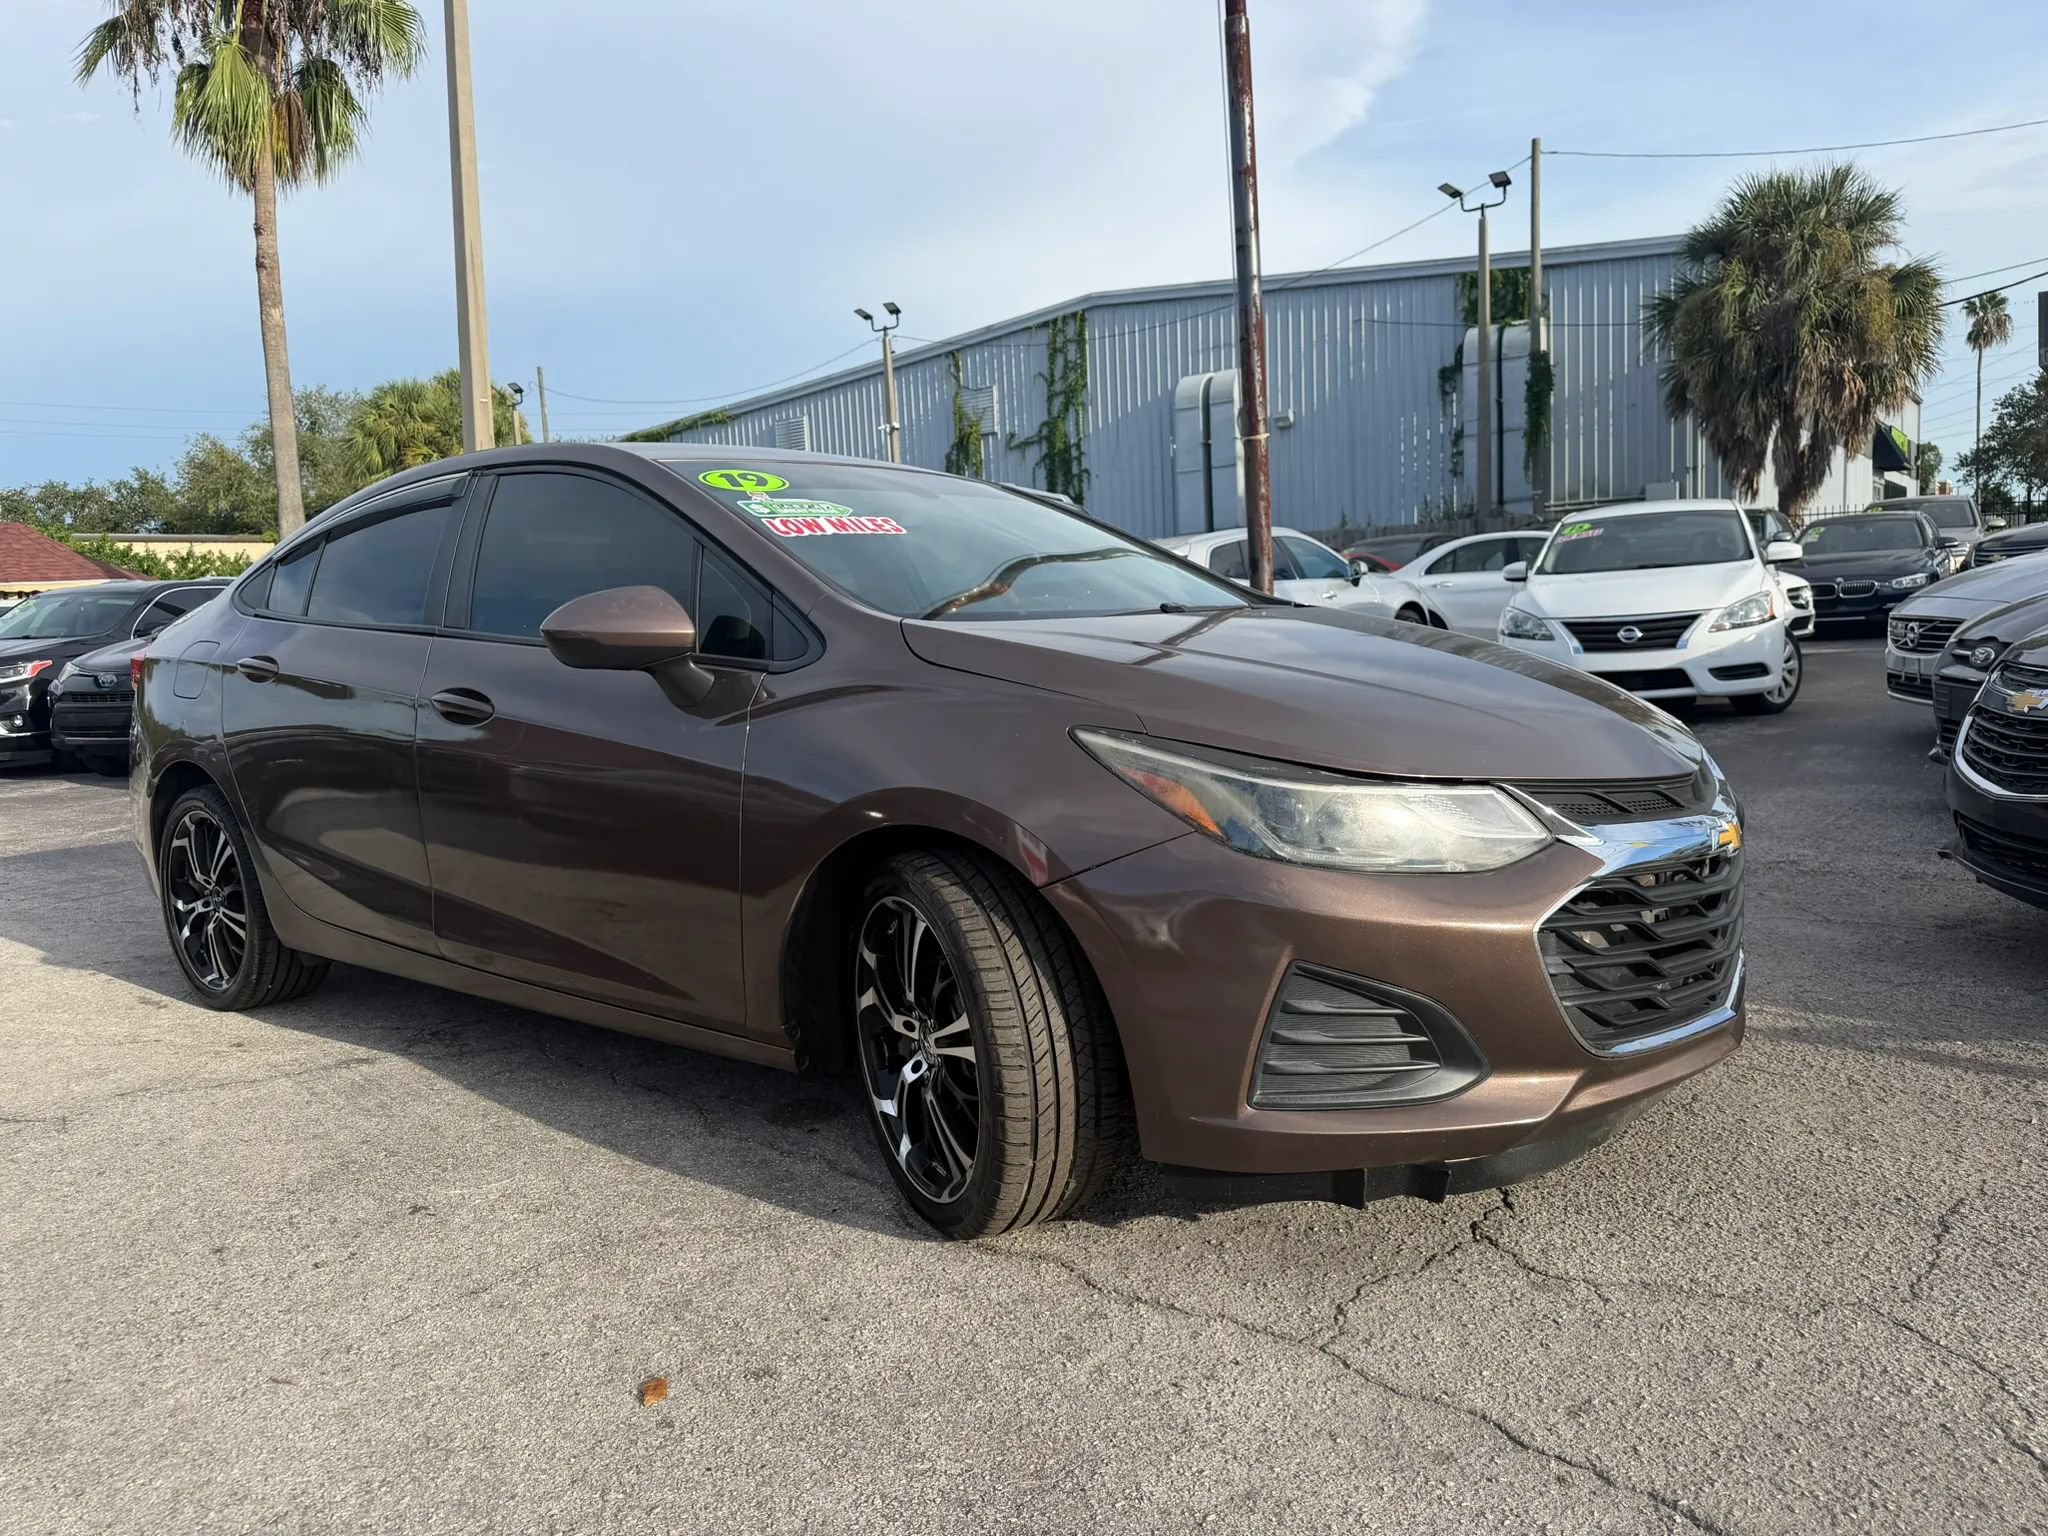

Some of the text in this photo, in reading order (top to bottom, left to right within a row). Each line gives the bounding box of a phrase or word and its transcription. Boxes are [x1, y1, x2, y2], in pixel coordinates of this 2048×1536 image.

[718, 473, 769, 488] 19
[764, 517, 905, 536] LOW MILES
